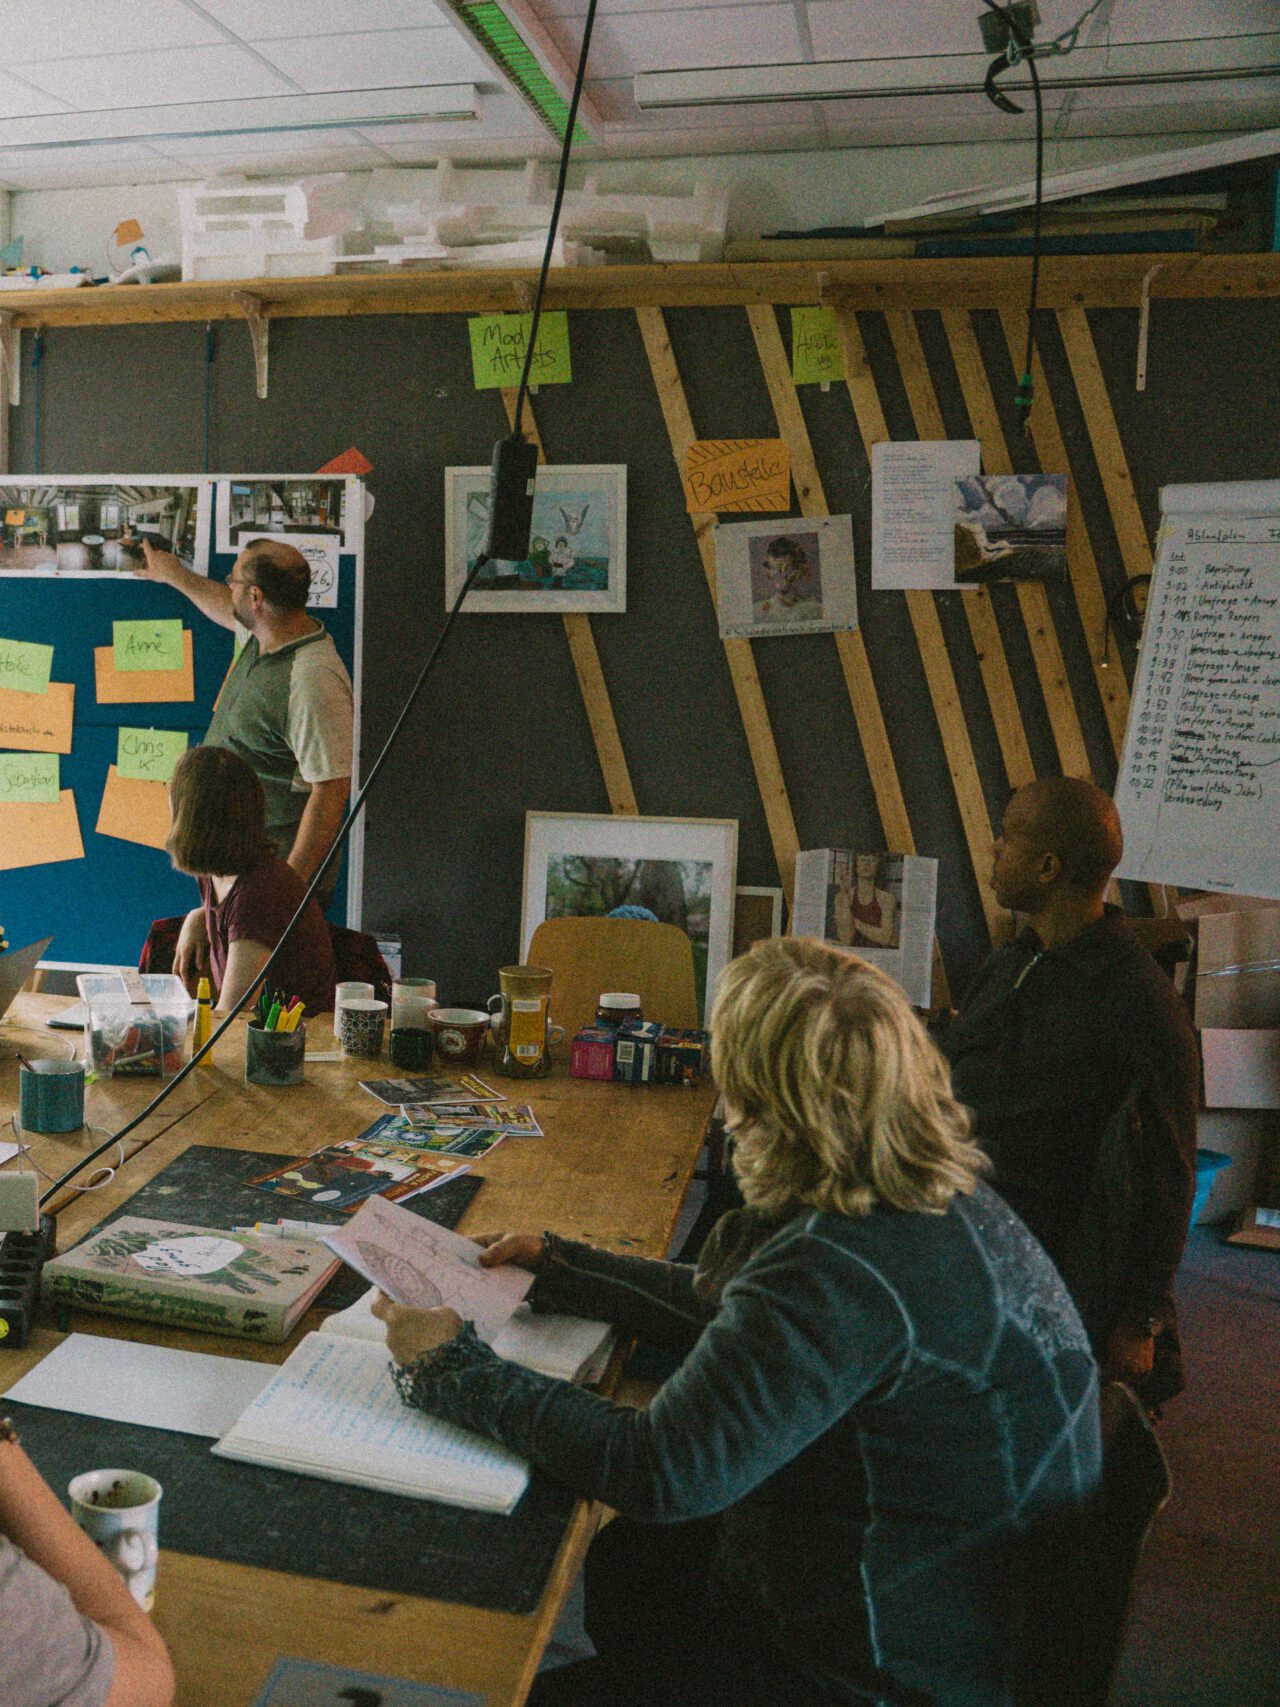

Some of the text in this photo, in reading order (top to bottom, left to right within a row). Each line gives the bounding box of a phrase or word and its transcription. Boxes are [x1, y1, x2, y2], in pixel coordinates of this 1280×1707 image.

[483, 323, 526, 347] Mad
[489, 342, 556, 372] Artsts
[687, 458, 786, 504] Baustelle
